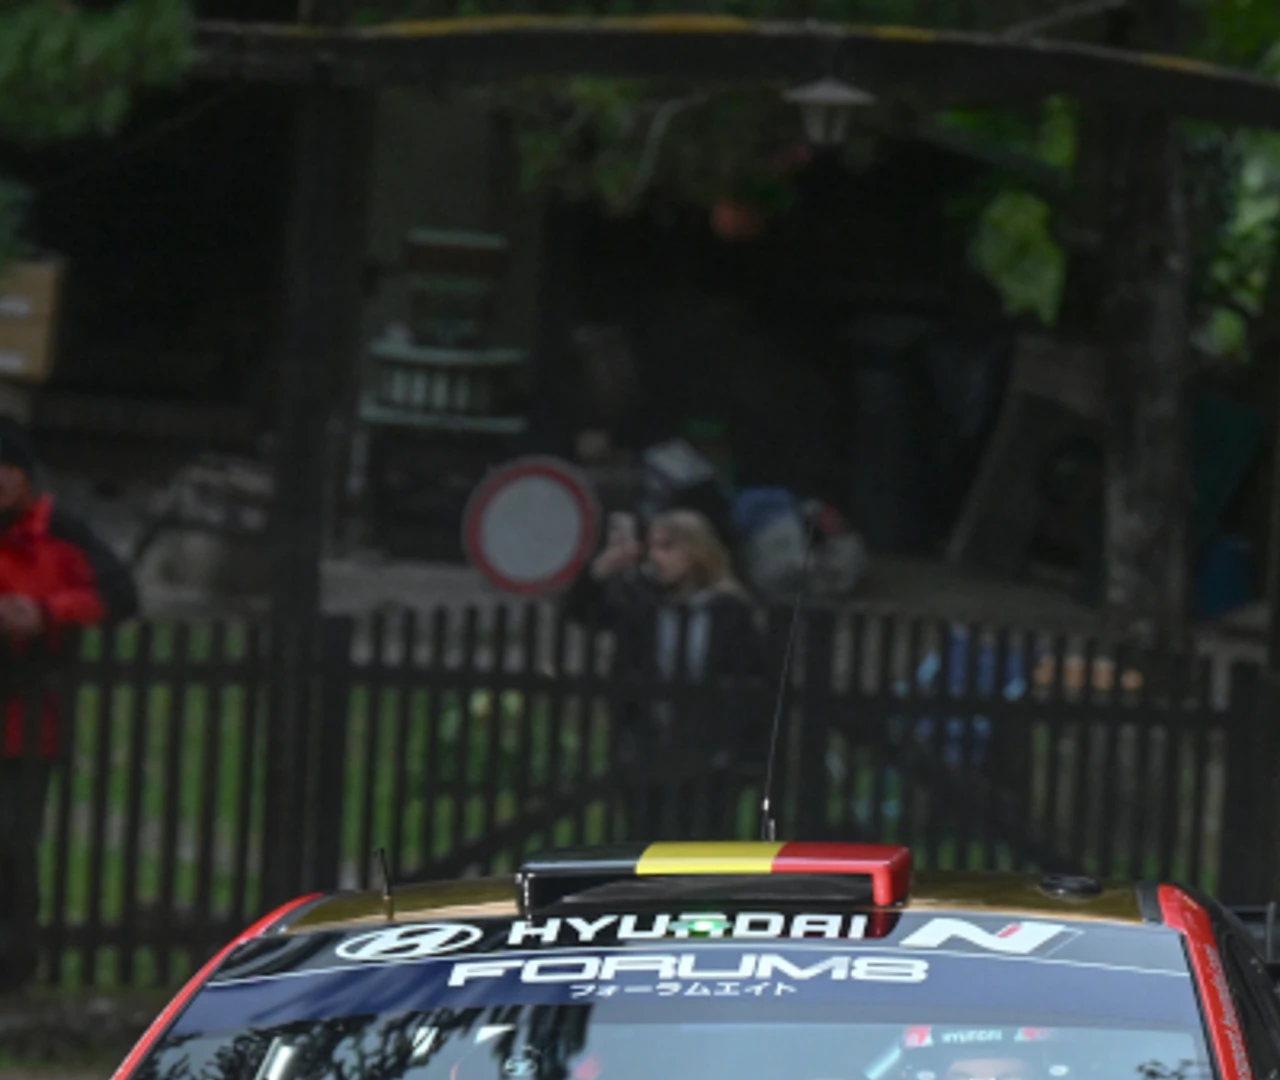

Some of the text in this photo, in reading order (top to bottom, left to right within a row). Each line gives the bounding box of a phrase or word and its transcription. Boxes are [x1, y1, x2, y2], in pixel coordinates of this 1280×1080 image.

[448, 954, 929, 986] FORUM8
[571, 983, 798, 999] フォーラムエイト
